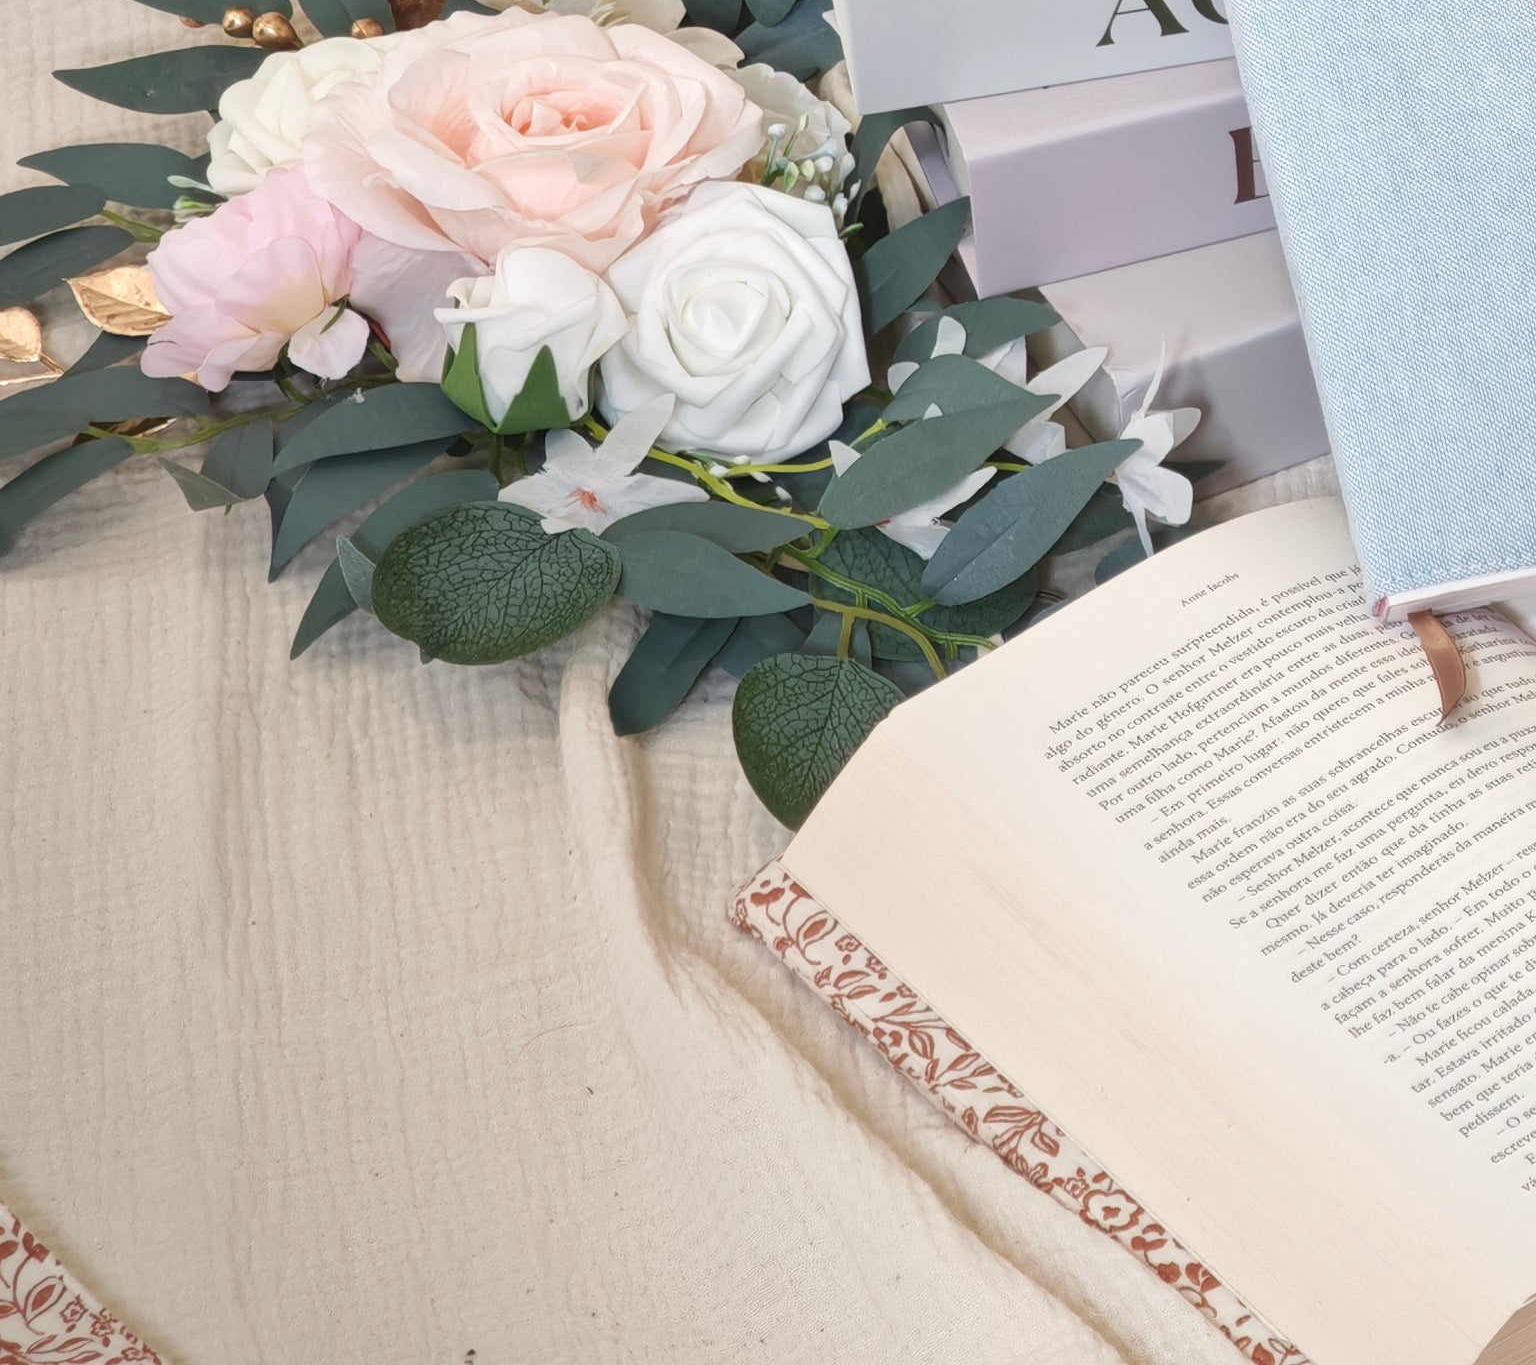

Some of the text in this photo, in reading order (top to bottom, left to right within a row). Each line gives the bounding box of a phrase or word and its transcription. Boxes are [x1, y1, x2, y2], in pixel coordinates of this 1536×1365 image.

[1181, 573, 1240, 608] Anne Jacobs
[1048, 707, 1090, 735] Marie
[1091, 690, 1117, 709] não
[1118, 657, 1170, 694] pareceu
[1171, 607, 1261, 659] surpreendida,
[1260, 597, 1270, 607] é
[1324, 570, 1349, 583] que
[1072, 749, 1130, 786] radiante.
[1127, 722, 1169, 750] Marie
[1240, 664, 1263, 680] era
[1261, 641, 1303, 669] pouco
[1303, 624, 1335, 643] mais
[1335, 613, 1371, 628] velha
[1201, 884, 1228, 903] não
[1228, 848, 1285, 886] esperava
[1285, 825, 1322, 850] outra
[1228, 916, 1249, 929] Se
[1248, 909, 1259, 919] a
[1259, 876, 1313, 912] senhora
[1311, 861, 1335, 879] me
[1333, 847, 1357, 864] faz
[1355, 828, 1387, 850] uma
[1386, 790, 1449, 832] pergunta,
[1448, 777, 1466, 790] eu
[1466, 760, 1498, 780] devo
[1260, 821, 1469, 957] mesmo. Já deveria ter imaginado.
[1290, 933, 1362, 983] deste bem?
[1347, 1022, 1373, 1039] lhe
[1371, 1007, 1396, 1025] faz
[1391, 988, 1427, 1010] bem
[1424, 966, 1456, 991] falar
[1458, 955, 1476, 970] da
[1476, 921, 1527, 958] menina
[1458, 1094, 1525, 1139] pedissem.
